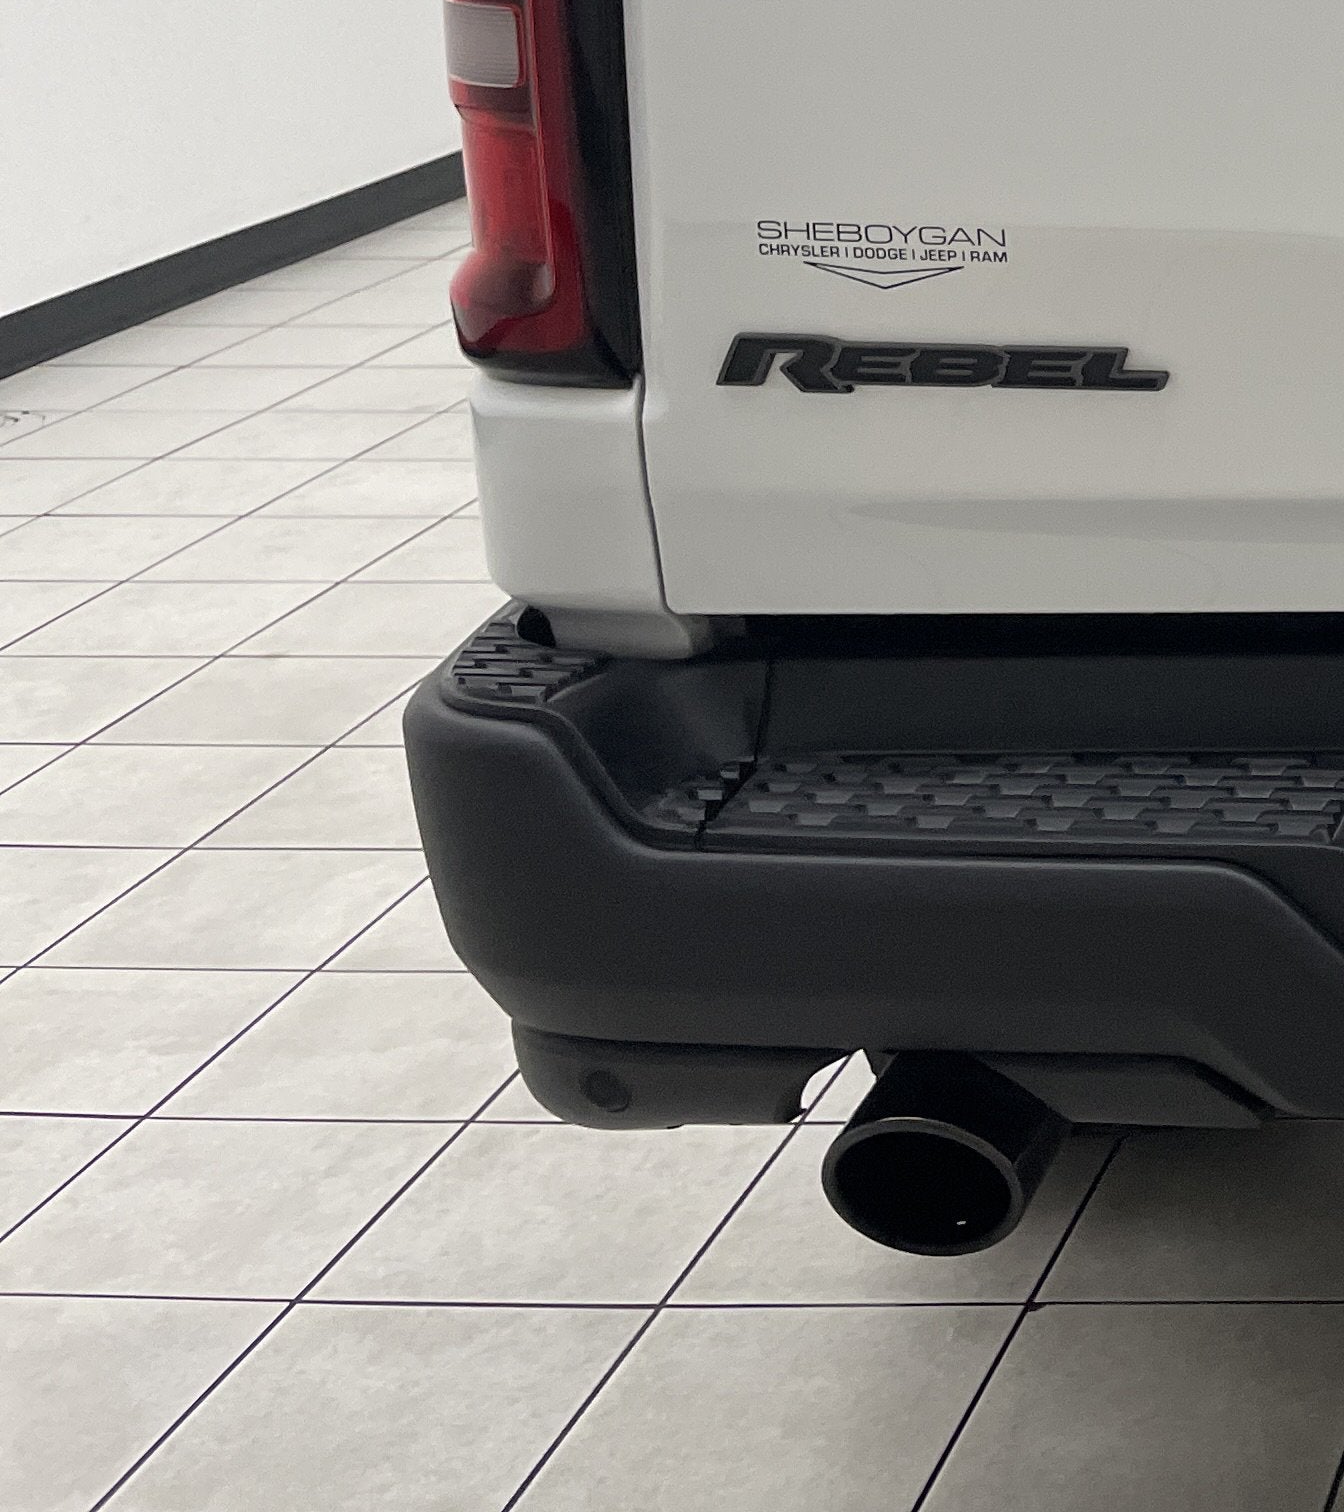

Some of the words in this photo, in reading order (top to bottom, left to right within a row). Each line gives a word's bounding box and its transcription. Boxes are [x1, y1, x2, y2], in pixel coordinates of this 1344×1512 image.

[757, 220, 1006, 247] SHEBOYGAN
[759, 243, 840, 258] CHRYSLER
[853, 247, 908, 261] DODGE
[919, 249, 957, 262] JEEP
[970, 250, 1008, 263] RAM
[716, 332, 1170, 394] REBEL
